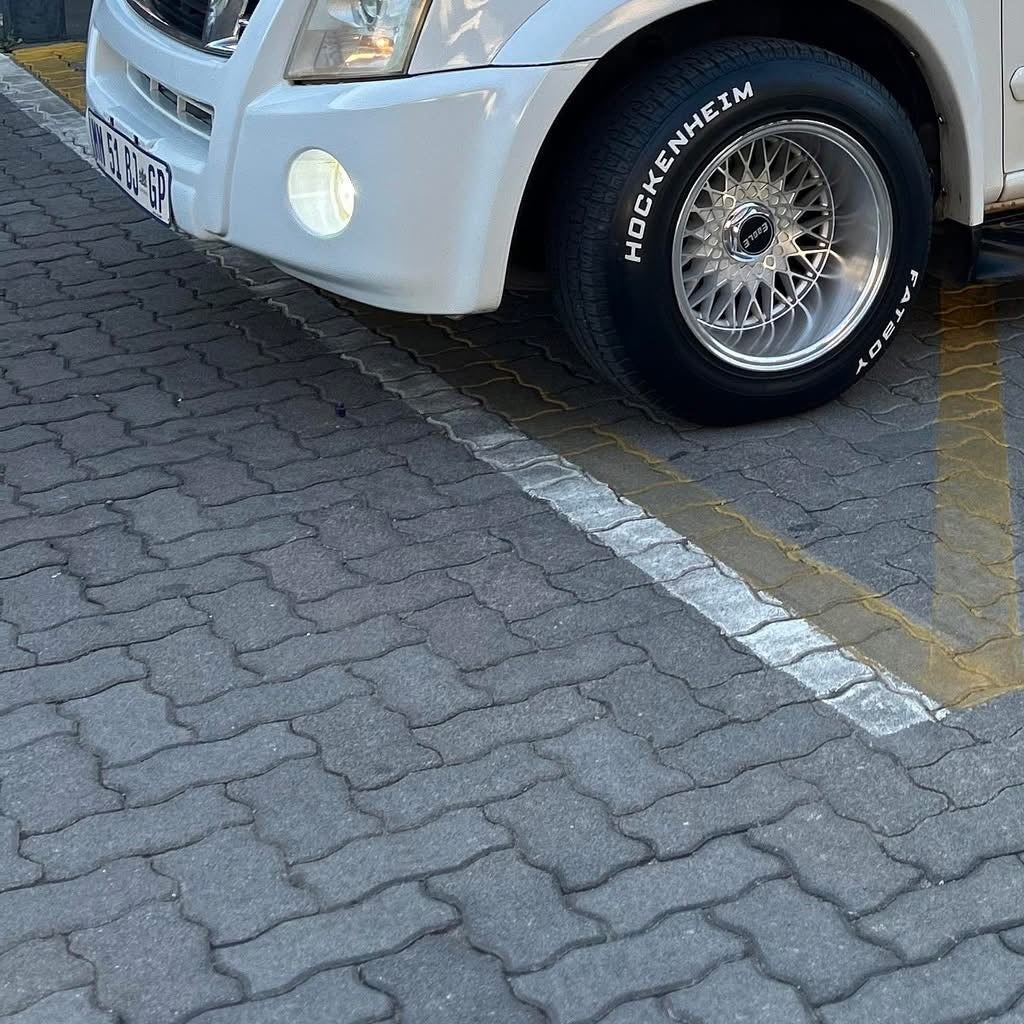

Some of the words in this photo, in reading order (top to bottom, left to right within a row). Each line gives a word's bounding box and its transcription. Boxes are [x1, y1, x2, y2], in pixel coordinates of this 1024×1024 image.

[124, 144, 139, 196] BJ
[148, 163, 166, 214] GP
[624, 80, 755, 264] HOCKENHEIM
[855, 267, 919, 376] FATBOY
